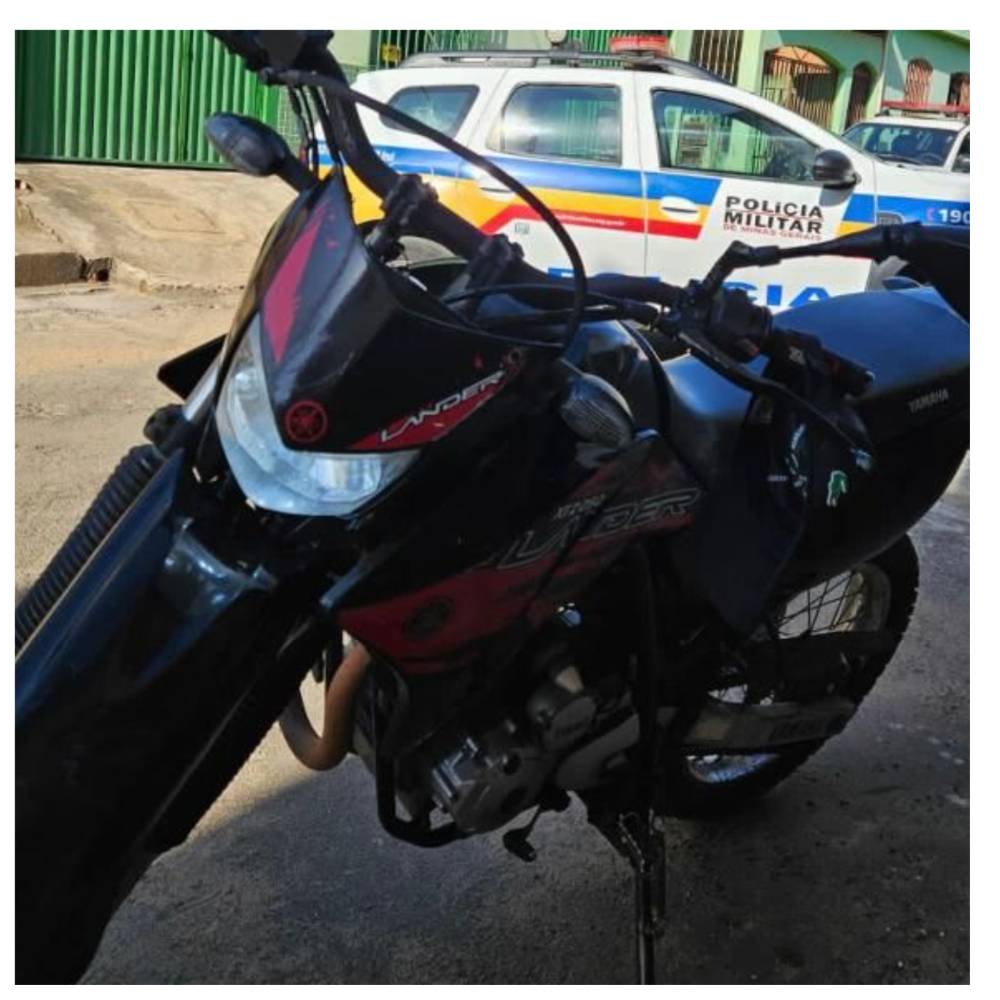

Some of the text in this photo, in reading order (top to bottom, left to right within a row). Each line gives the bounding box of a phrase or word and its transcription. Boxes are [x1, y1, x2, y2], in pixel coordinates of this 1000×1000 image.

[723, 212, 823, 235] MILITAR
[742, 226, 777, 237] MINAS
[779, 230, 823, 241] GERAIS
[381, 369, 507, 443] LANDER
